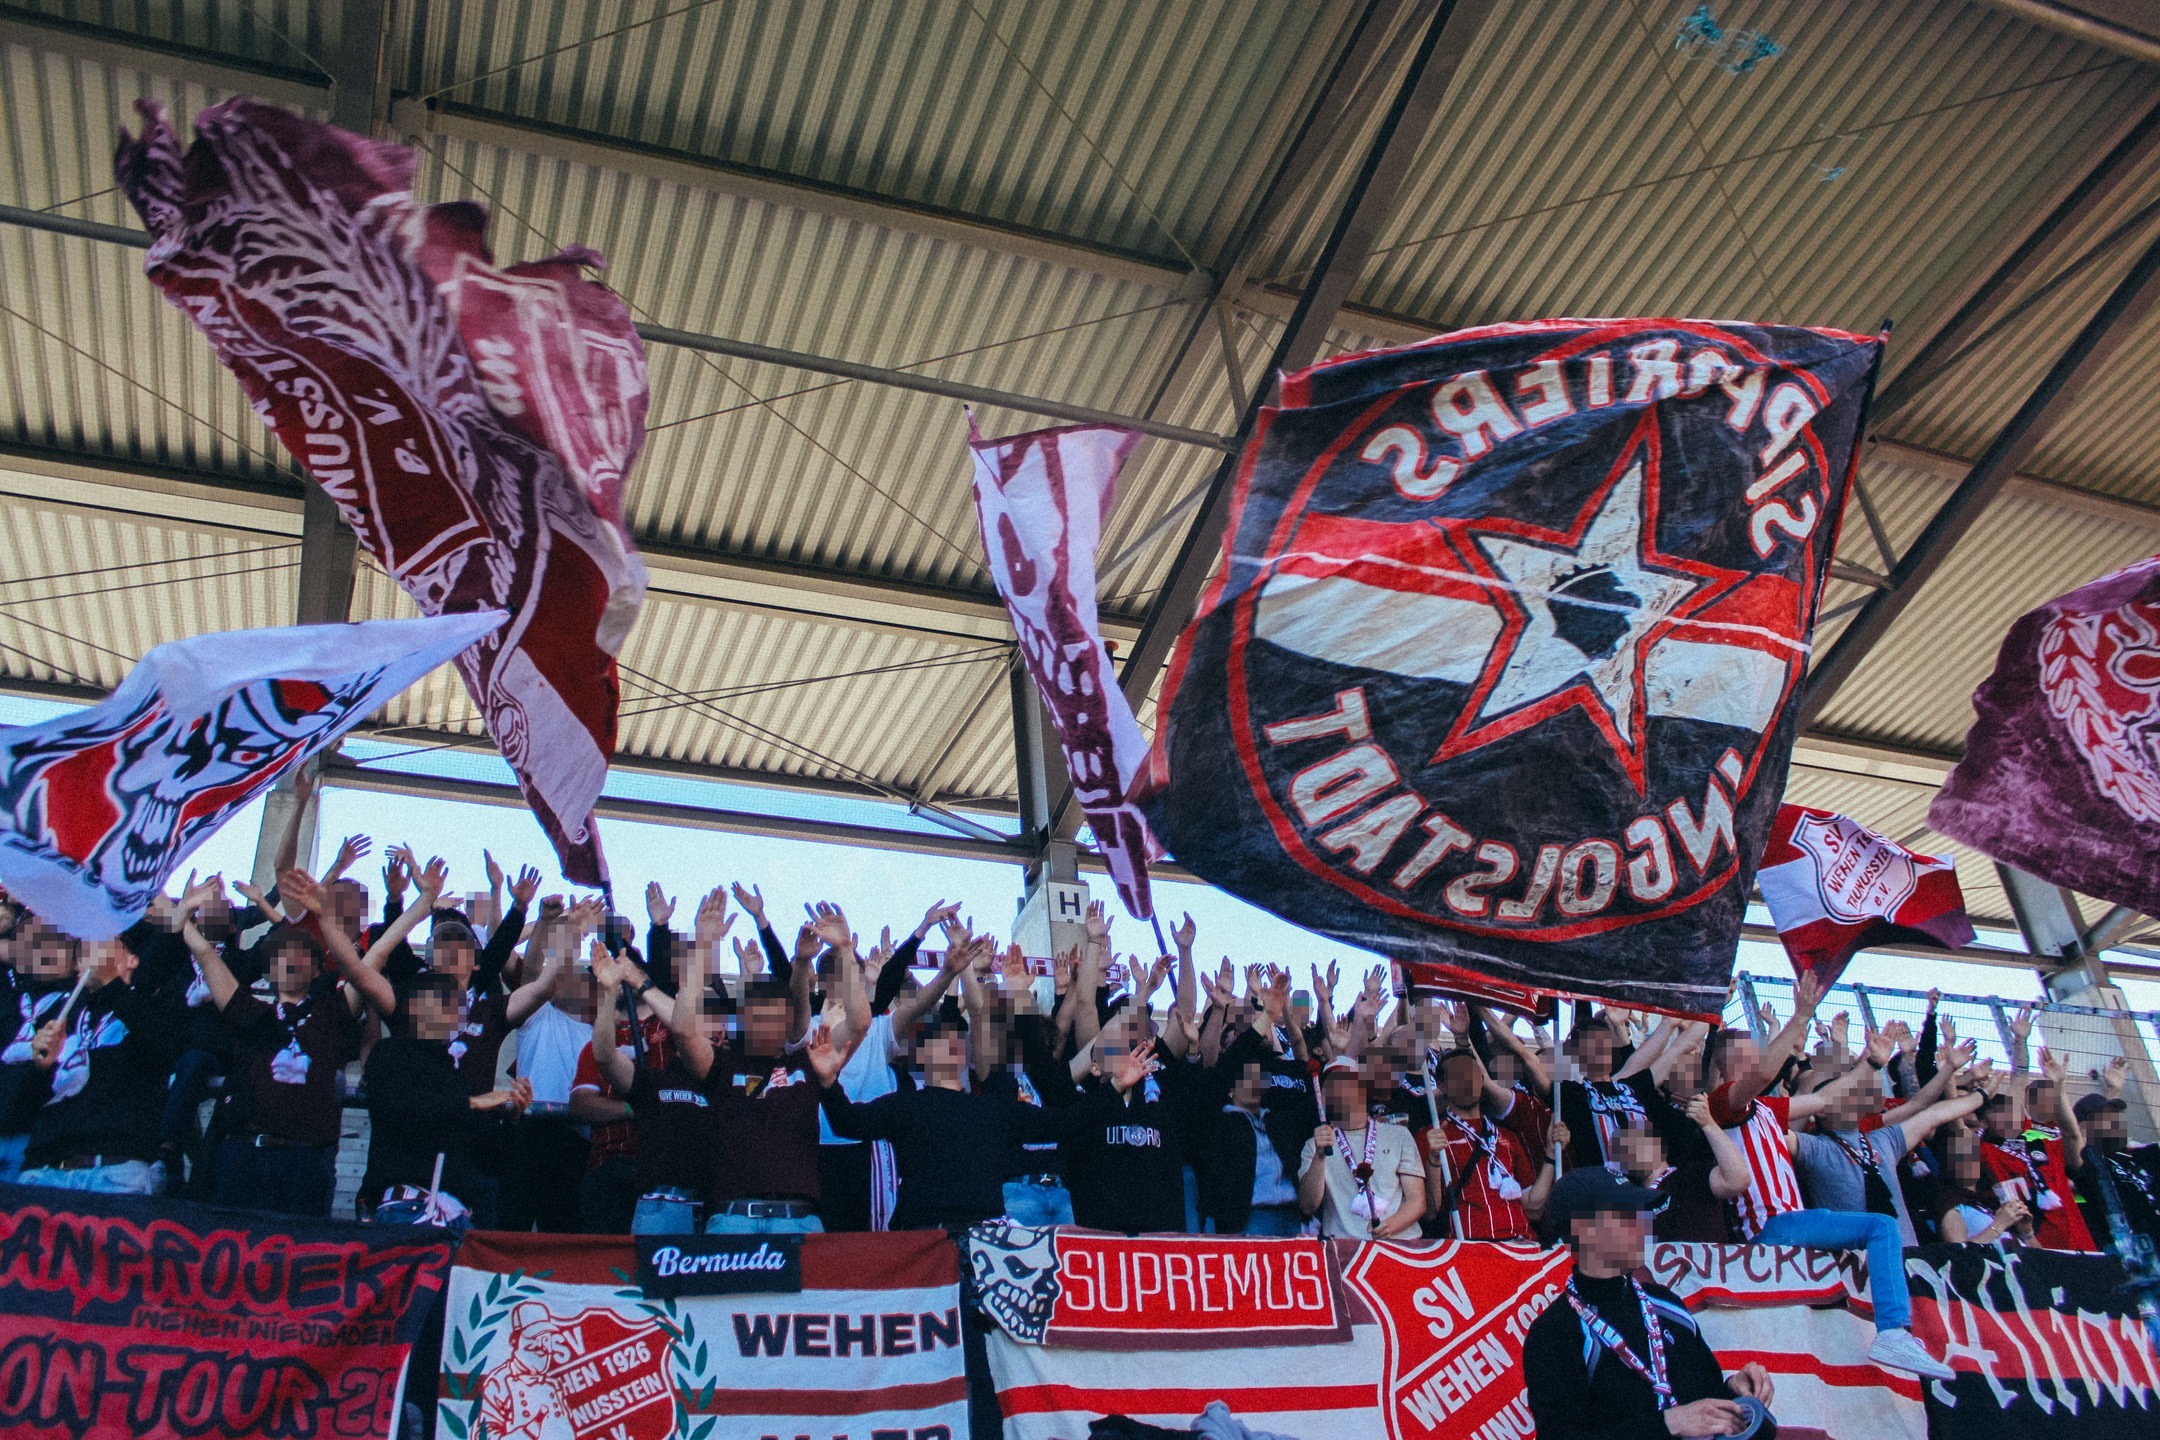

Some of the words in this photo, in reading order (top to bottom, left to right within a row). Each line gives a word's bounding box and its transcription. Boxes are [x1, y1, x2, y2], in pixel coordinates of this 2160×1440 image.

[1823, 823, 1844, 854] SV
[1827, 846, 1862, 894] WEHEN
[1059, 891, 1081, 916] H
[651, 1242, 786, 1277] Bermuda
[1063, 1249, 1325, 1313] SUPREMUS
[1412, 1266, 1475, 1339] SV
[550, 1326, 586, 1364] SV
[732, 1306, 961, 1358] WEHEN
[602, 1341, 652, 1377] 1926
[1401, 1331, 1514, 1432] WEHEN
